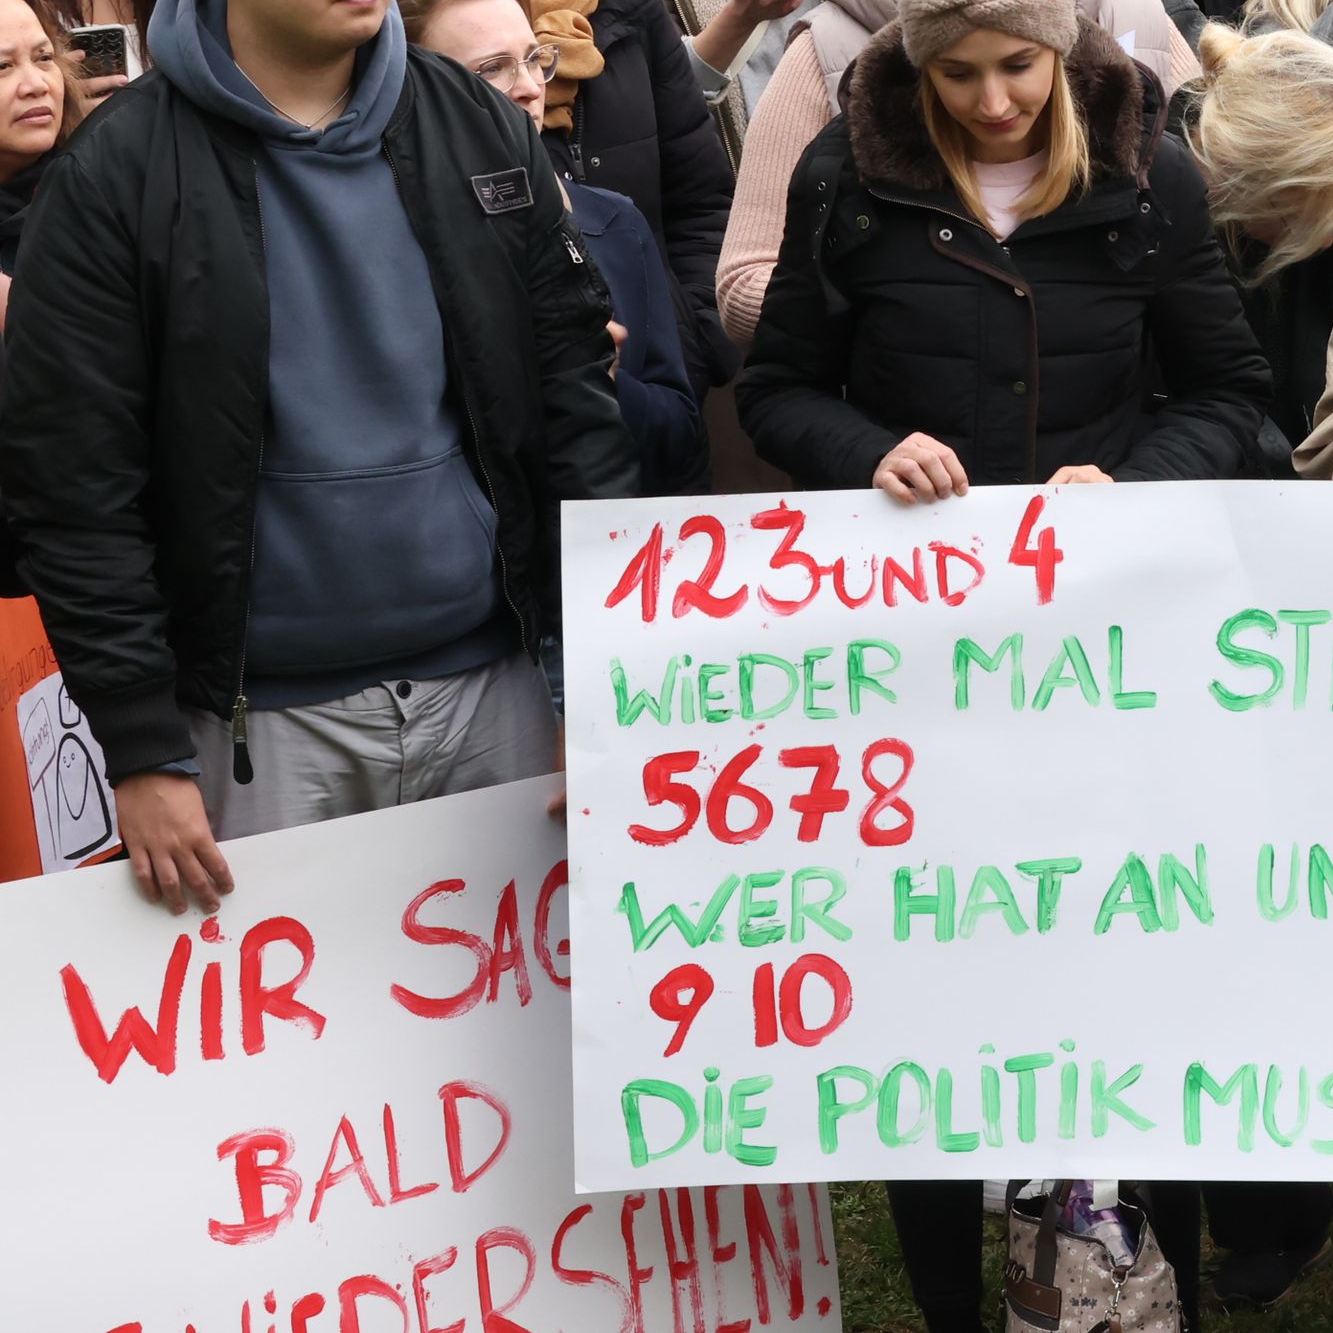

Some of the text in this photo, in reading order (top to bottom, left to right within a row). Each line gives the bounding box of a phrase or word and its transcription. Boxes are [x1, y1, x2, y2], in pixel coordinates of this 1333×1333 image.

[951, 625, 1158, 712] MAL
[615, 865, 853, 954] WER
[648, 950, 854, 1058] 9 10
[207, 1079, 513, 1247] BALD
